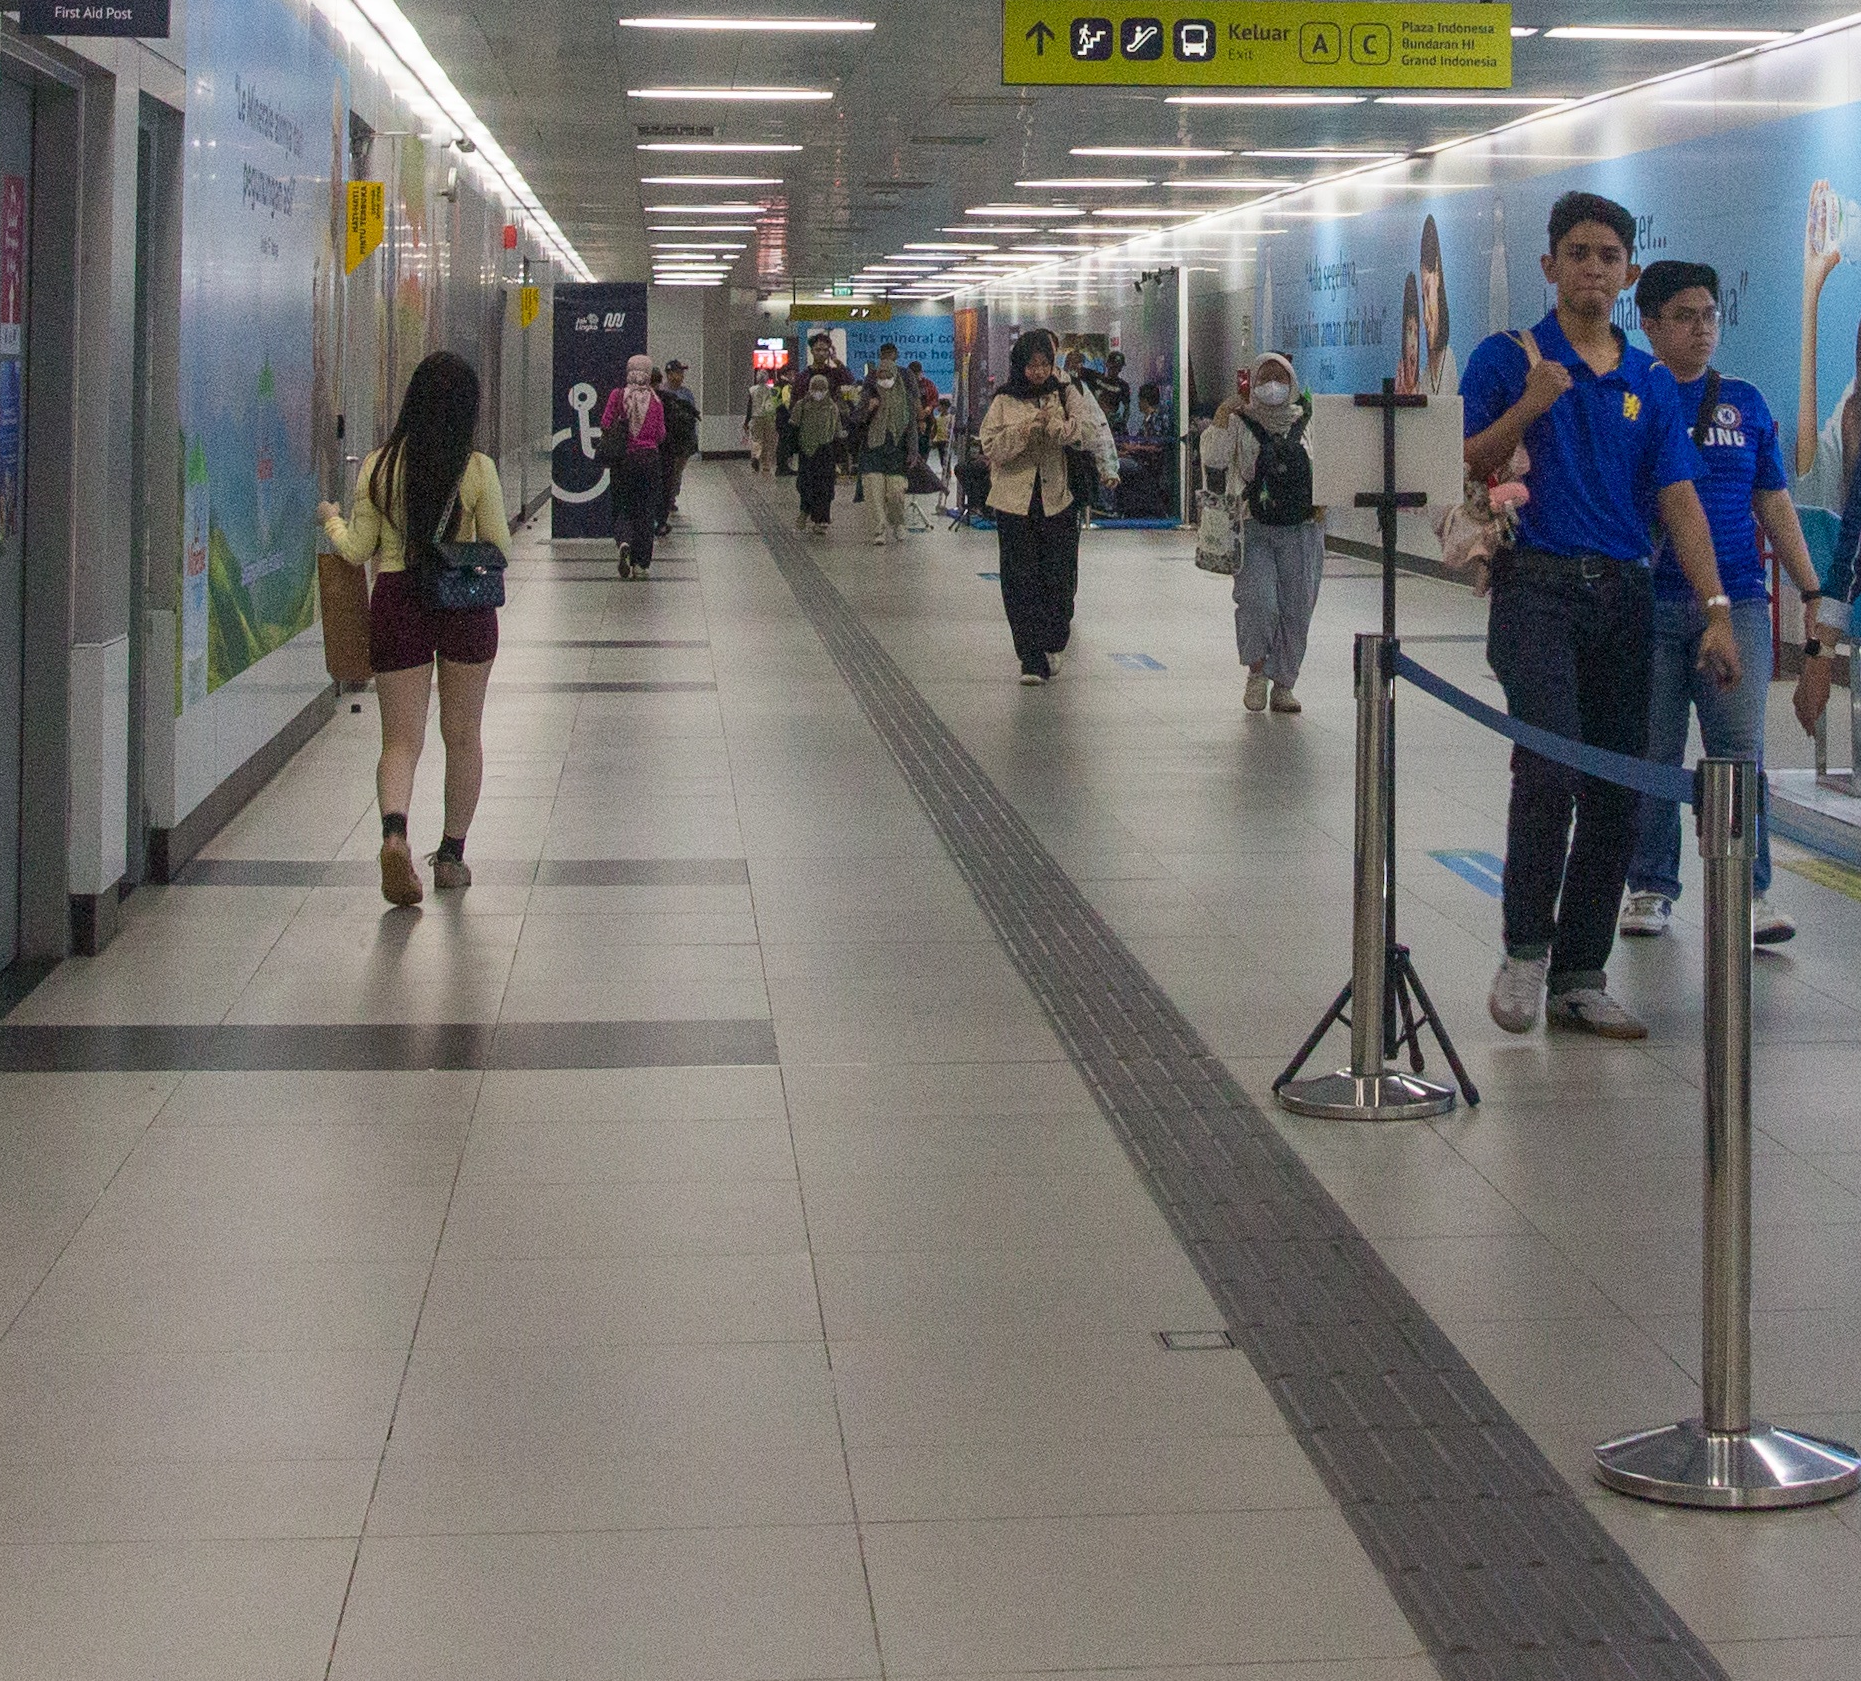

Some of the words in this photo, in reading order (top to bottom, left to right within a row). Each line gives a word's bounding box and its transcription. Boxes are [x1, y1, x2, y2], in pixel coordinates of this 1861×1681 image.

[54, 6, 80, 20] First
[83, 6, 103, 20] Aid
[105, 6, 132, 20] Post
[1228, 22, 1290, 42] Keluar
[1401, 21, 1434, 34] Plaza
[1438, 22, 1495, 34] Indonesia
[1312, 33, 1328, 55] A
[1362, 34, 1378, 55] C
[1401, 38, 1459, 50] Bundaran
[1228, 47, 1254, 62] Exit
[1401, 55, 1437, 66] Grand
[1440, 55, 1497, 68] Indonesia
